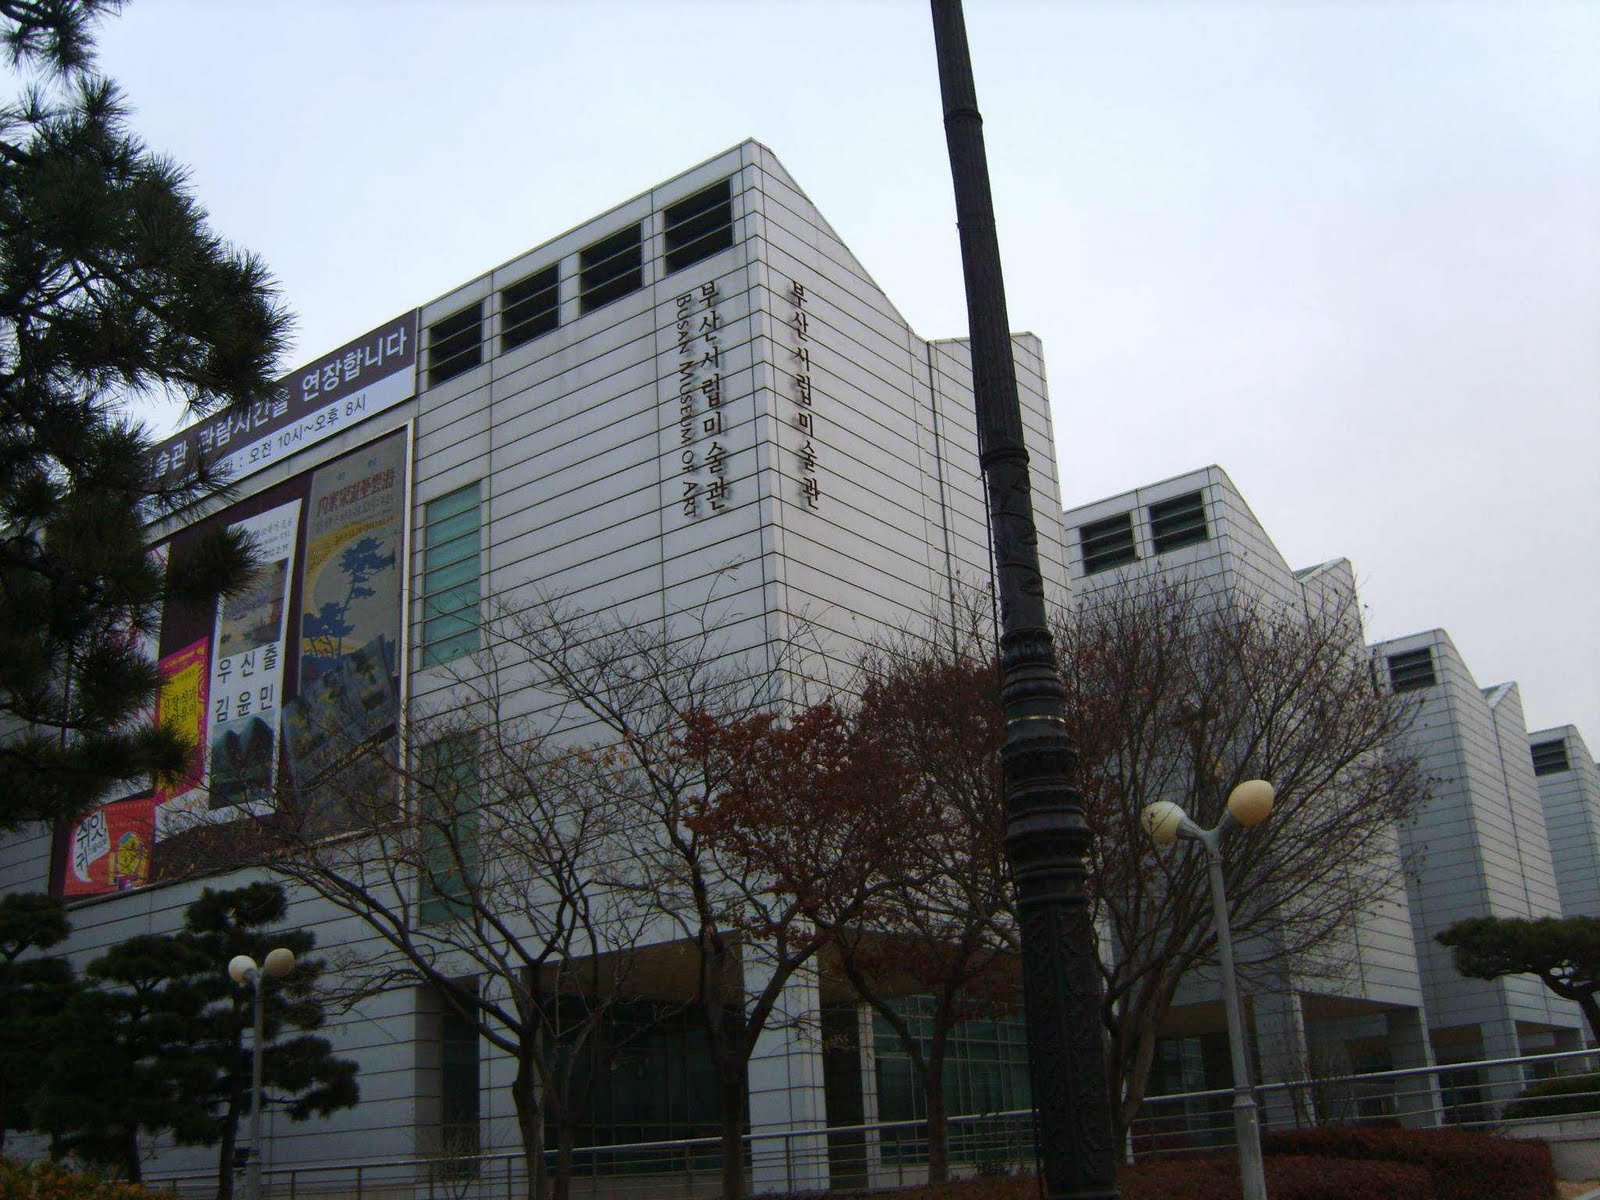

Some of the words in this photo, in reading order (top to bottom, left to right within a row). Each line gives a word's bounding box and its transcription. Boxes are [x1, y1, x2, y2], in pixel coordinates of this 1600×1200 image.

[675, 293, 693, 355] BUSAN
[301, 325, 408, 402] 연장합니다
[698, 280, 727, 511] 부산시립미술관
[792, 280, 821, 510] 부산시립미술관
[249, 443, 273, 467] 오전
[345, 393, 367, 418] 8시
[678, 359, 694, 446] MUSEUM
[681, 449, 696, 475] OF
[682, 480, 699, 518] ART
